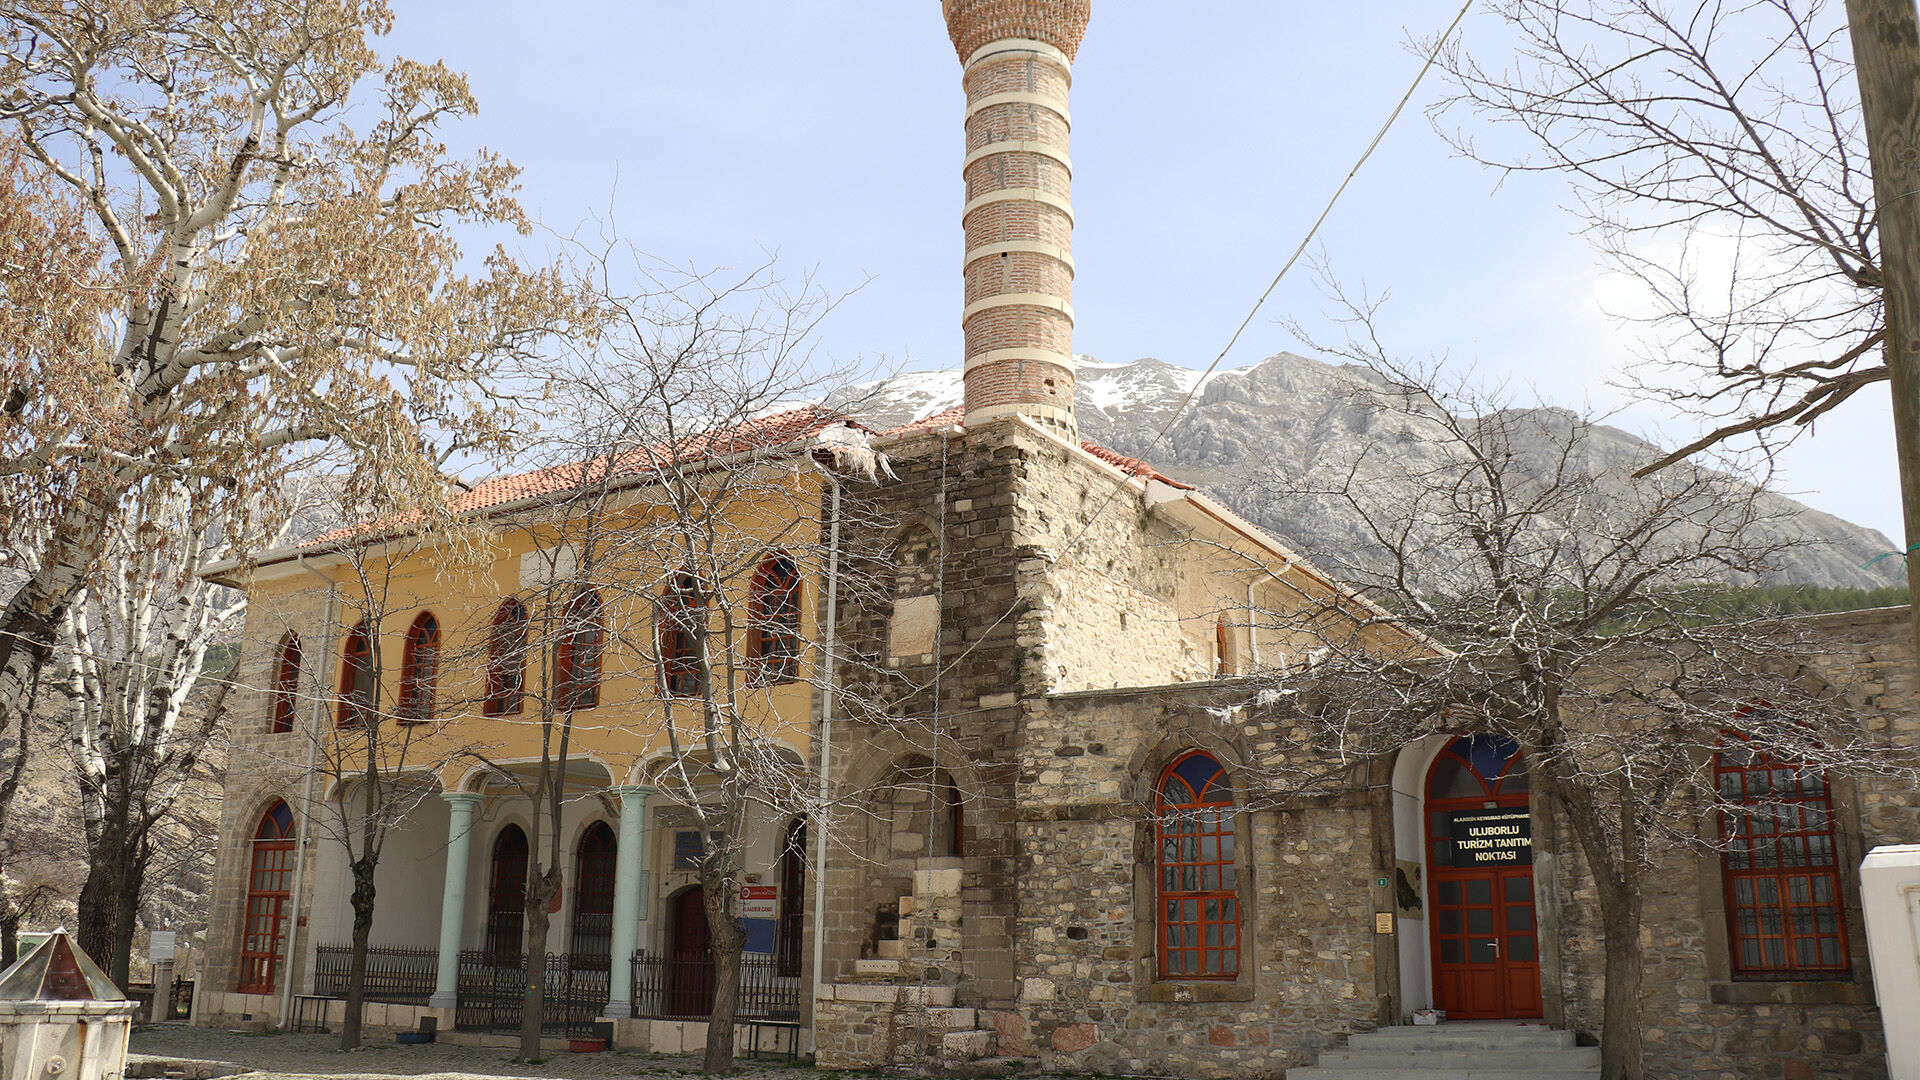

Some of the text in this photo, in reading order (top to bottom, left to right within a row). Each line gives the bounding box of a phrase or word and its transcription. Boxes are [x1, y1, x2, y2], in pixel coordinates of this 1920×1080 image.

[1469, 825, 1520, 837] ULUBORLU
[1457, 837, 1532, 850] TURİZM TANITIM
[1475, 851, 1517, 861] NOKTASI
